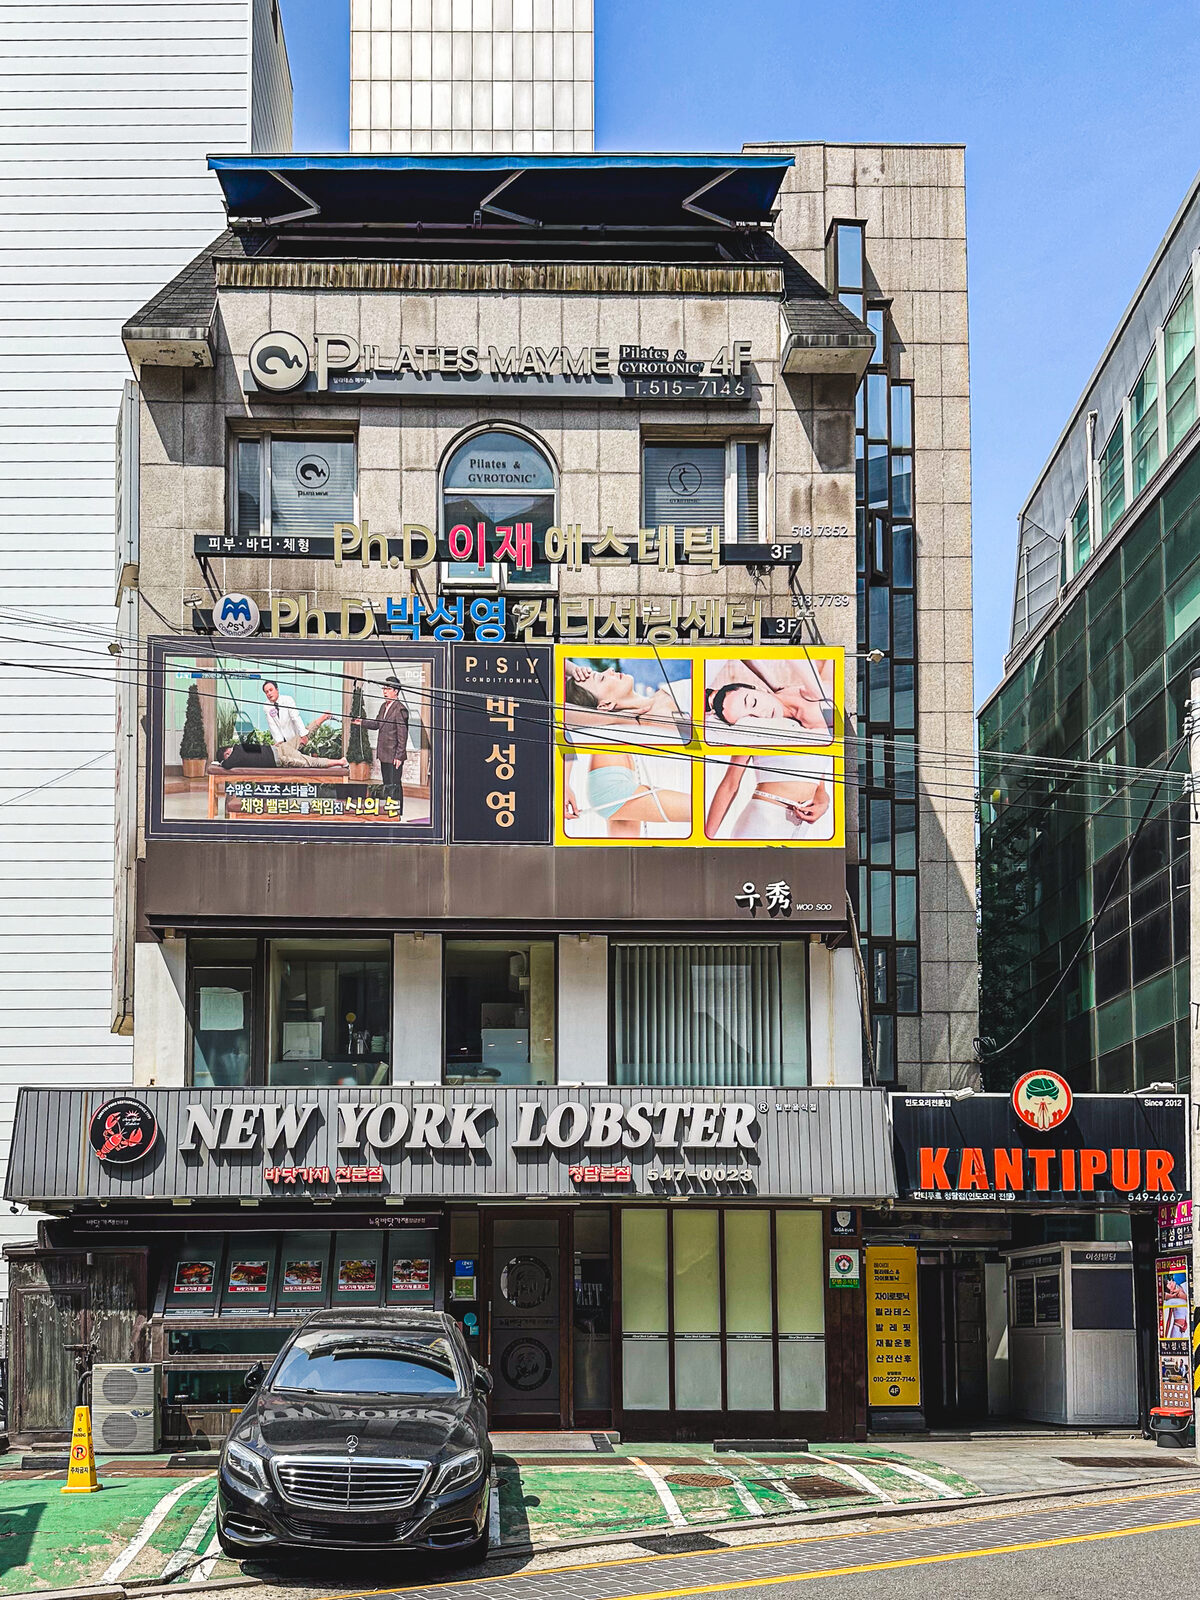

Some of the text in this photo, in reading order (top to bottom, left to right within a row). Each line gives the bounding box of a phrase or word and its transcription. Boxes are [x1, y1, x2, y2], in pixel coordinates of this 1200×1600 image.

[622, 346, 686, 361] Pilates &
[711, 340, 752, 377] 4F
[313, 333, 609, 391] PILATES MAYME
[633, 380, 745, 396] T.515-7146
[470, 459, 521, 469] Pilates &
[791, 525, 848, 538] 518.7352
[333, 519, 720, 573] Ph.D 이재 에스테틱
[770, 544, 793, 560] 3F
[226, 620, 246, 631] PSY
[271, 594, 378, 640] Ph.D
[386, 597, 506, 642] 박성영
[775, 618, 797, 634] 3F
[254, 785, 281, 796] 스포츠
[240, 798, 264, 815] 체형
[345, 797, 380, 816] 신의
[384, 796, 401, 817] 손
[796, 903, 814, 911] WOO
[815, 903, 832, 911] SOO
[1144, 1099, 1182, 1107] Since 2012
[178, 1101, 757, 1151] NEW YORK LOBSTER
[264, 1166, 384, 1184] 바닷가재 전문점
[569, 1165, 631, 1183] 청담본점
[647, 1168, 753, 1182] 547-0023
[919, 1147, 1175, 1192] KANTIPUR
[1128, 1193, 1183, 1201] 549-4667
